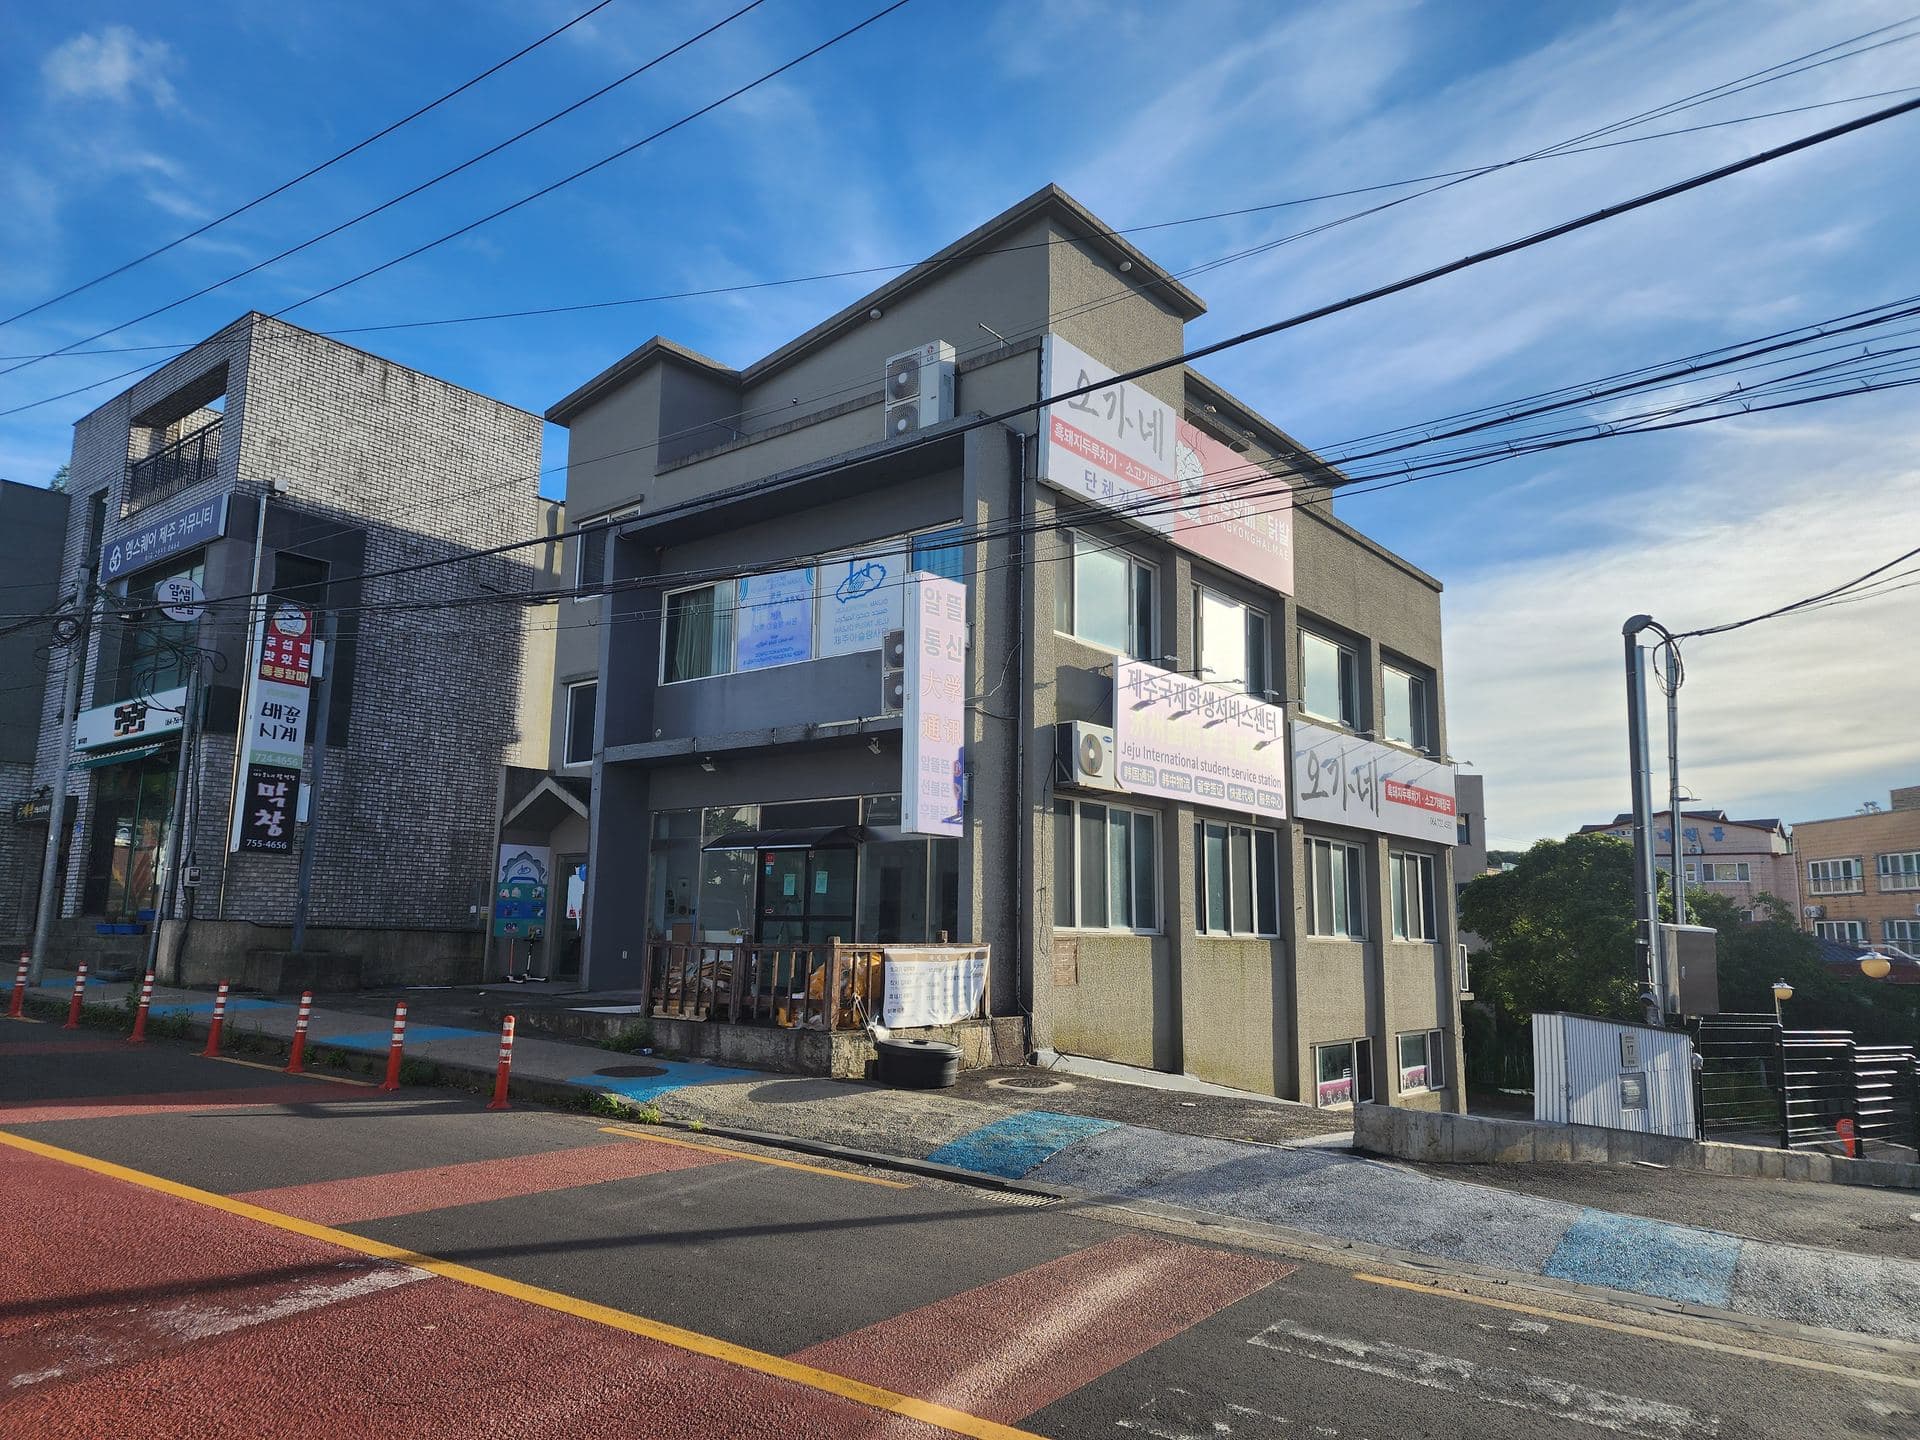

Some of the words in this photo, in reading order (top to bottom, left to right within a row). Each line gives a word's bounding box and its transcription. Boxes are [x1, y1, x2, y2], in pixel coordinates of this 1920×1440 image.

[1067, 369, 1164, 462] 오가네
[1055, 422, 1117, 470] 흑돼지두루치기
[159, 521, 176, 544] 제주
[179, 504, 214, 536] 커뮤니티
[924, 627, 963, 663] 통신
[260, 701, 301, 724] 배꼽
[1127, 668, 1277, 738] 제주국제학생서비스센터
[259, 722, 297, 743] 시계
[1121, 742, 1141, 760] Jeju
[1143, 744, 1200, 769] International
[1200, 758, 1231, 777] student
[1231, 768, 1257, 787] service
[1257, 774, 1282, 789] station
[1301, 745, 1380, 818] 오가네
[246, 839, 287, 850] 755-4656
